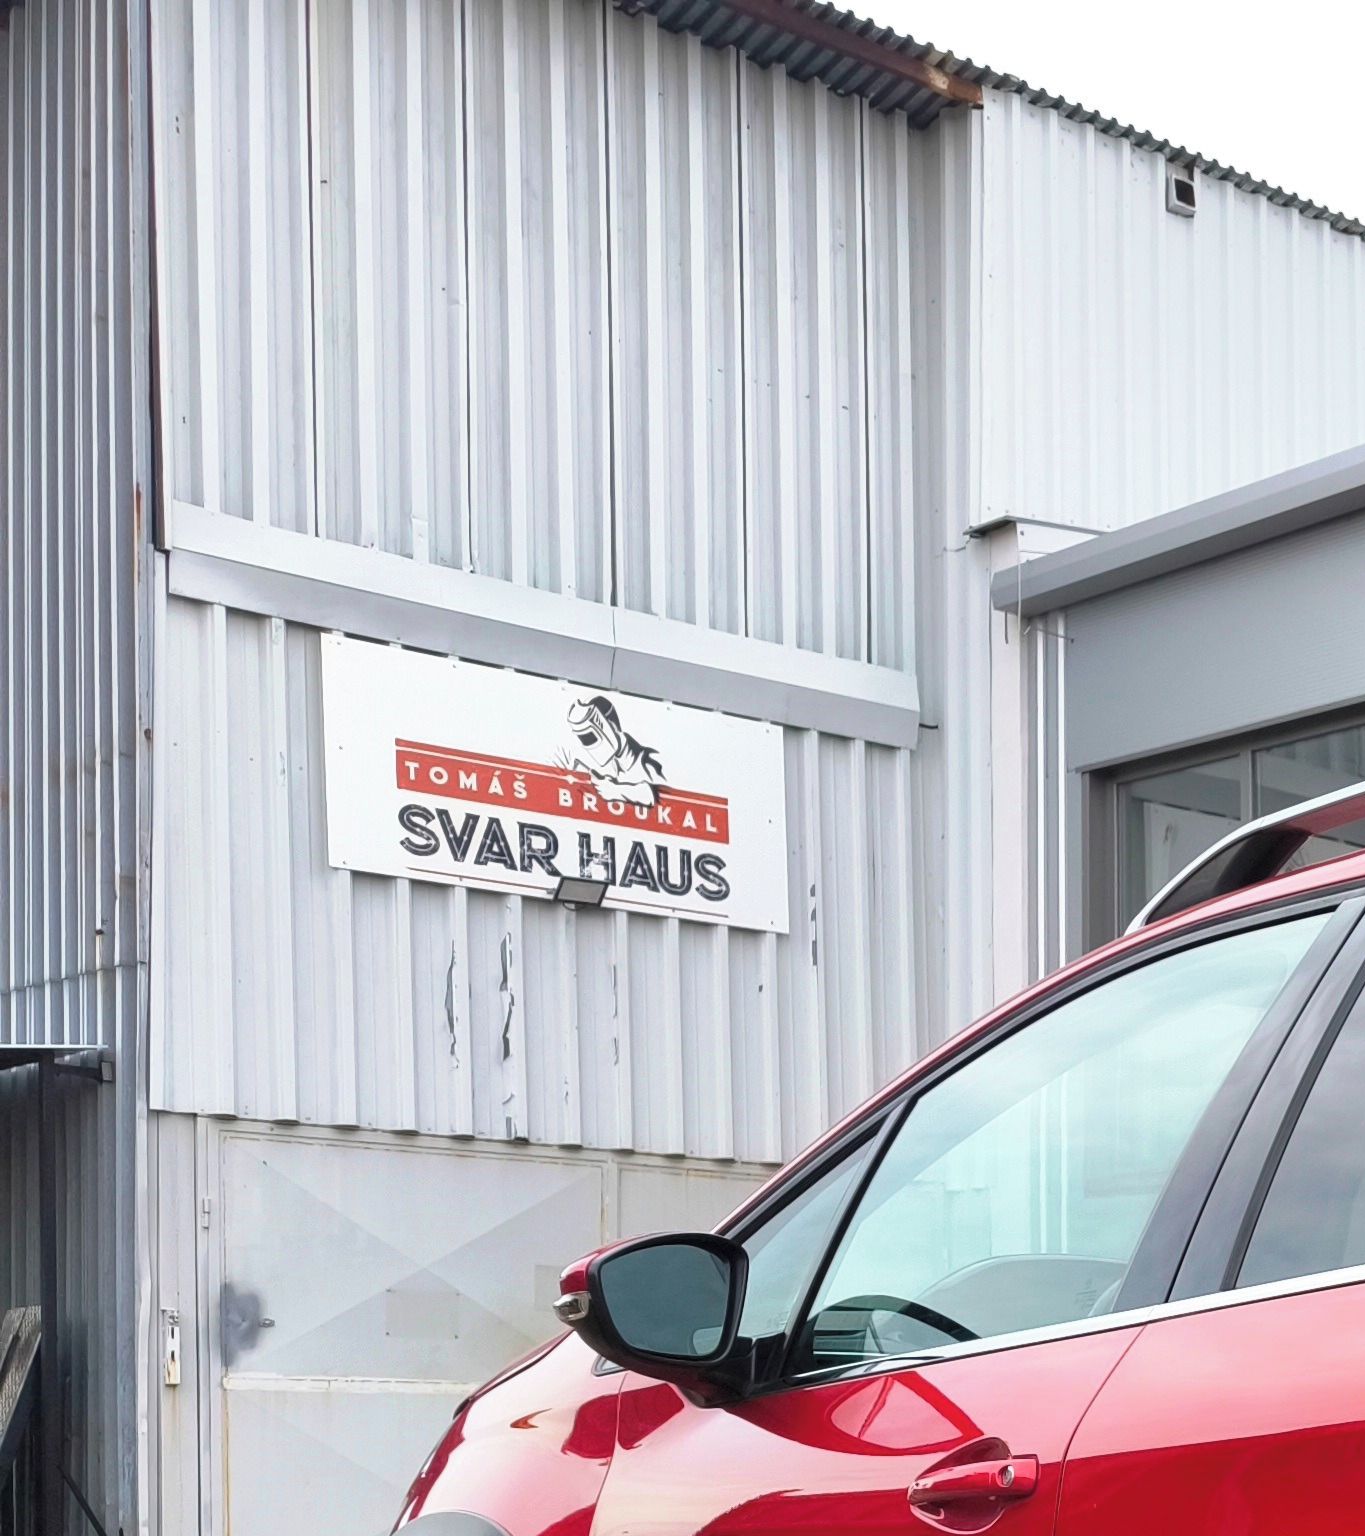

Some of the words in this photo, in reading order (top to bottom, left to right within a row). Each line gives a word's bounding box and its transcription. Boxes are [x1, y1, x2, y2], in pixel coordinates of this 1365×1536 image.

[404, 760, 528, 799] TOMÁŠ
[558, 787, 719, 833] BROUKAL
[398, 804, 563, 877] SVAR
[576, 831, 731, 902] HAUS
